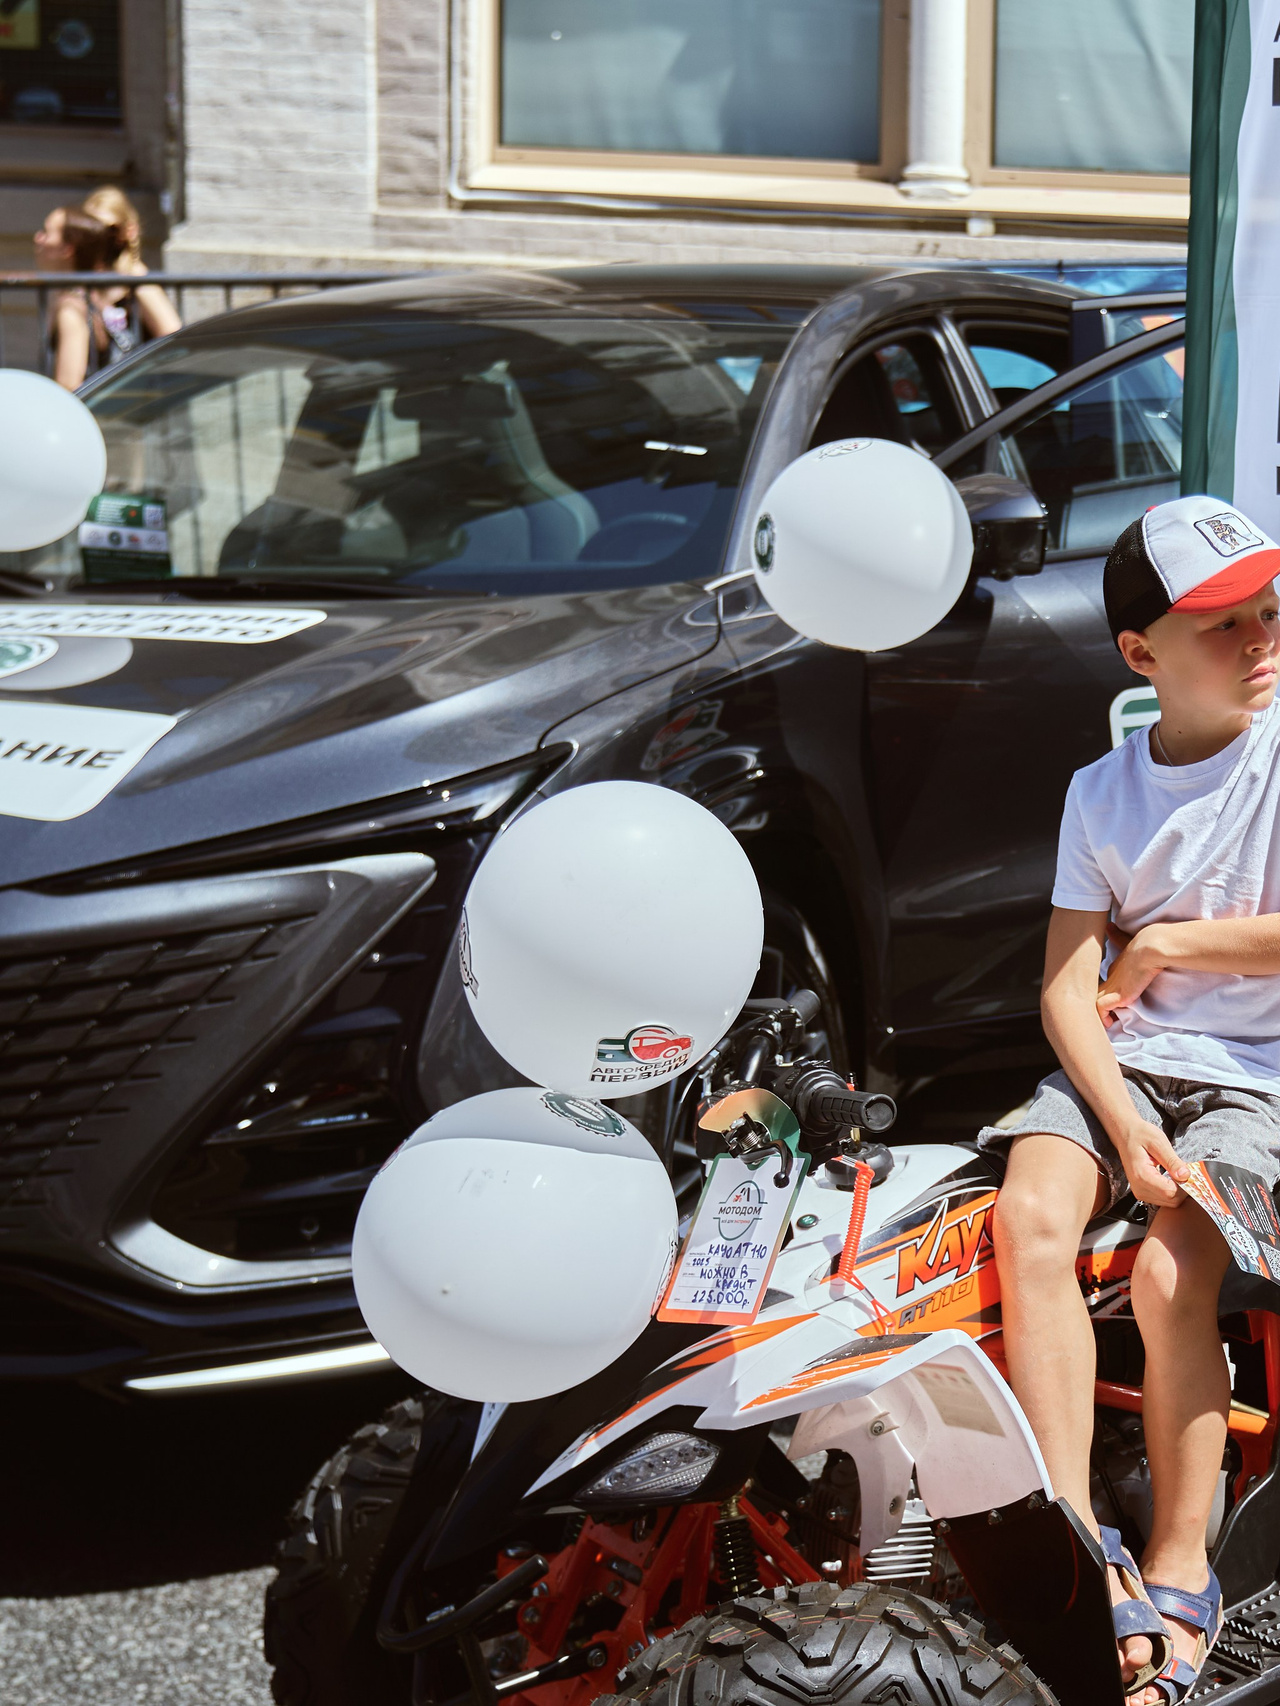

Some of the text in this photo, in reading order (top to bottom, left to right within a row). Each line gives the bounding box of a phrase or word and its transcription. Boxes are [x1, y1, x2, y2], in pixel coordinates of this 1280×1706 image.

[0, 738, 125, 768] НИЕ
[592, 1053, 689, 1074] АВТОКРЕДИТ
[718, 1206, 762, 1216] МОТОДОМ
[700, 1265, 736, 1279] МОЖНО
[898, 1275, 975, 1329] AT110
